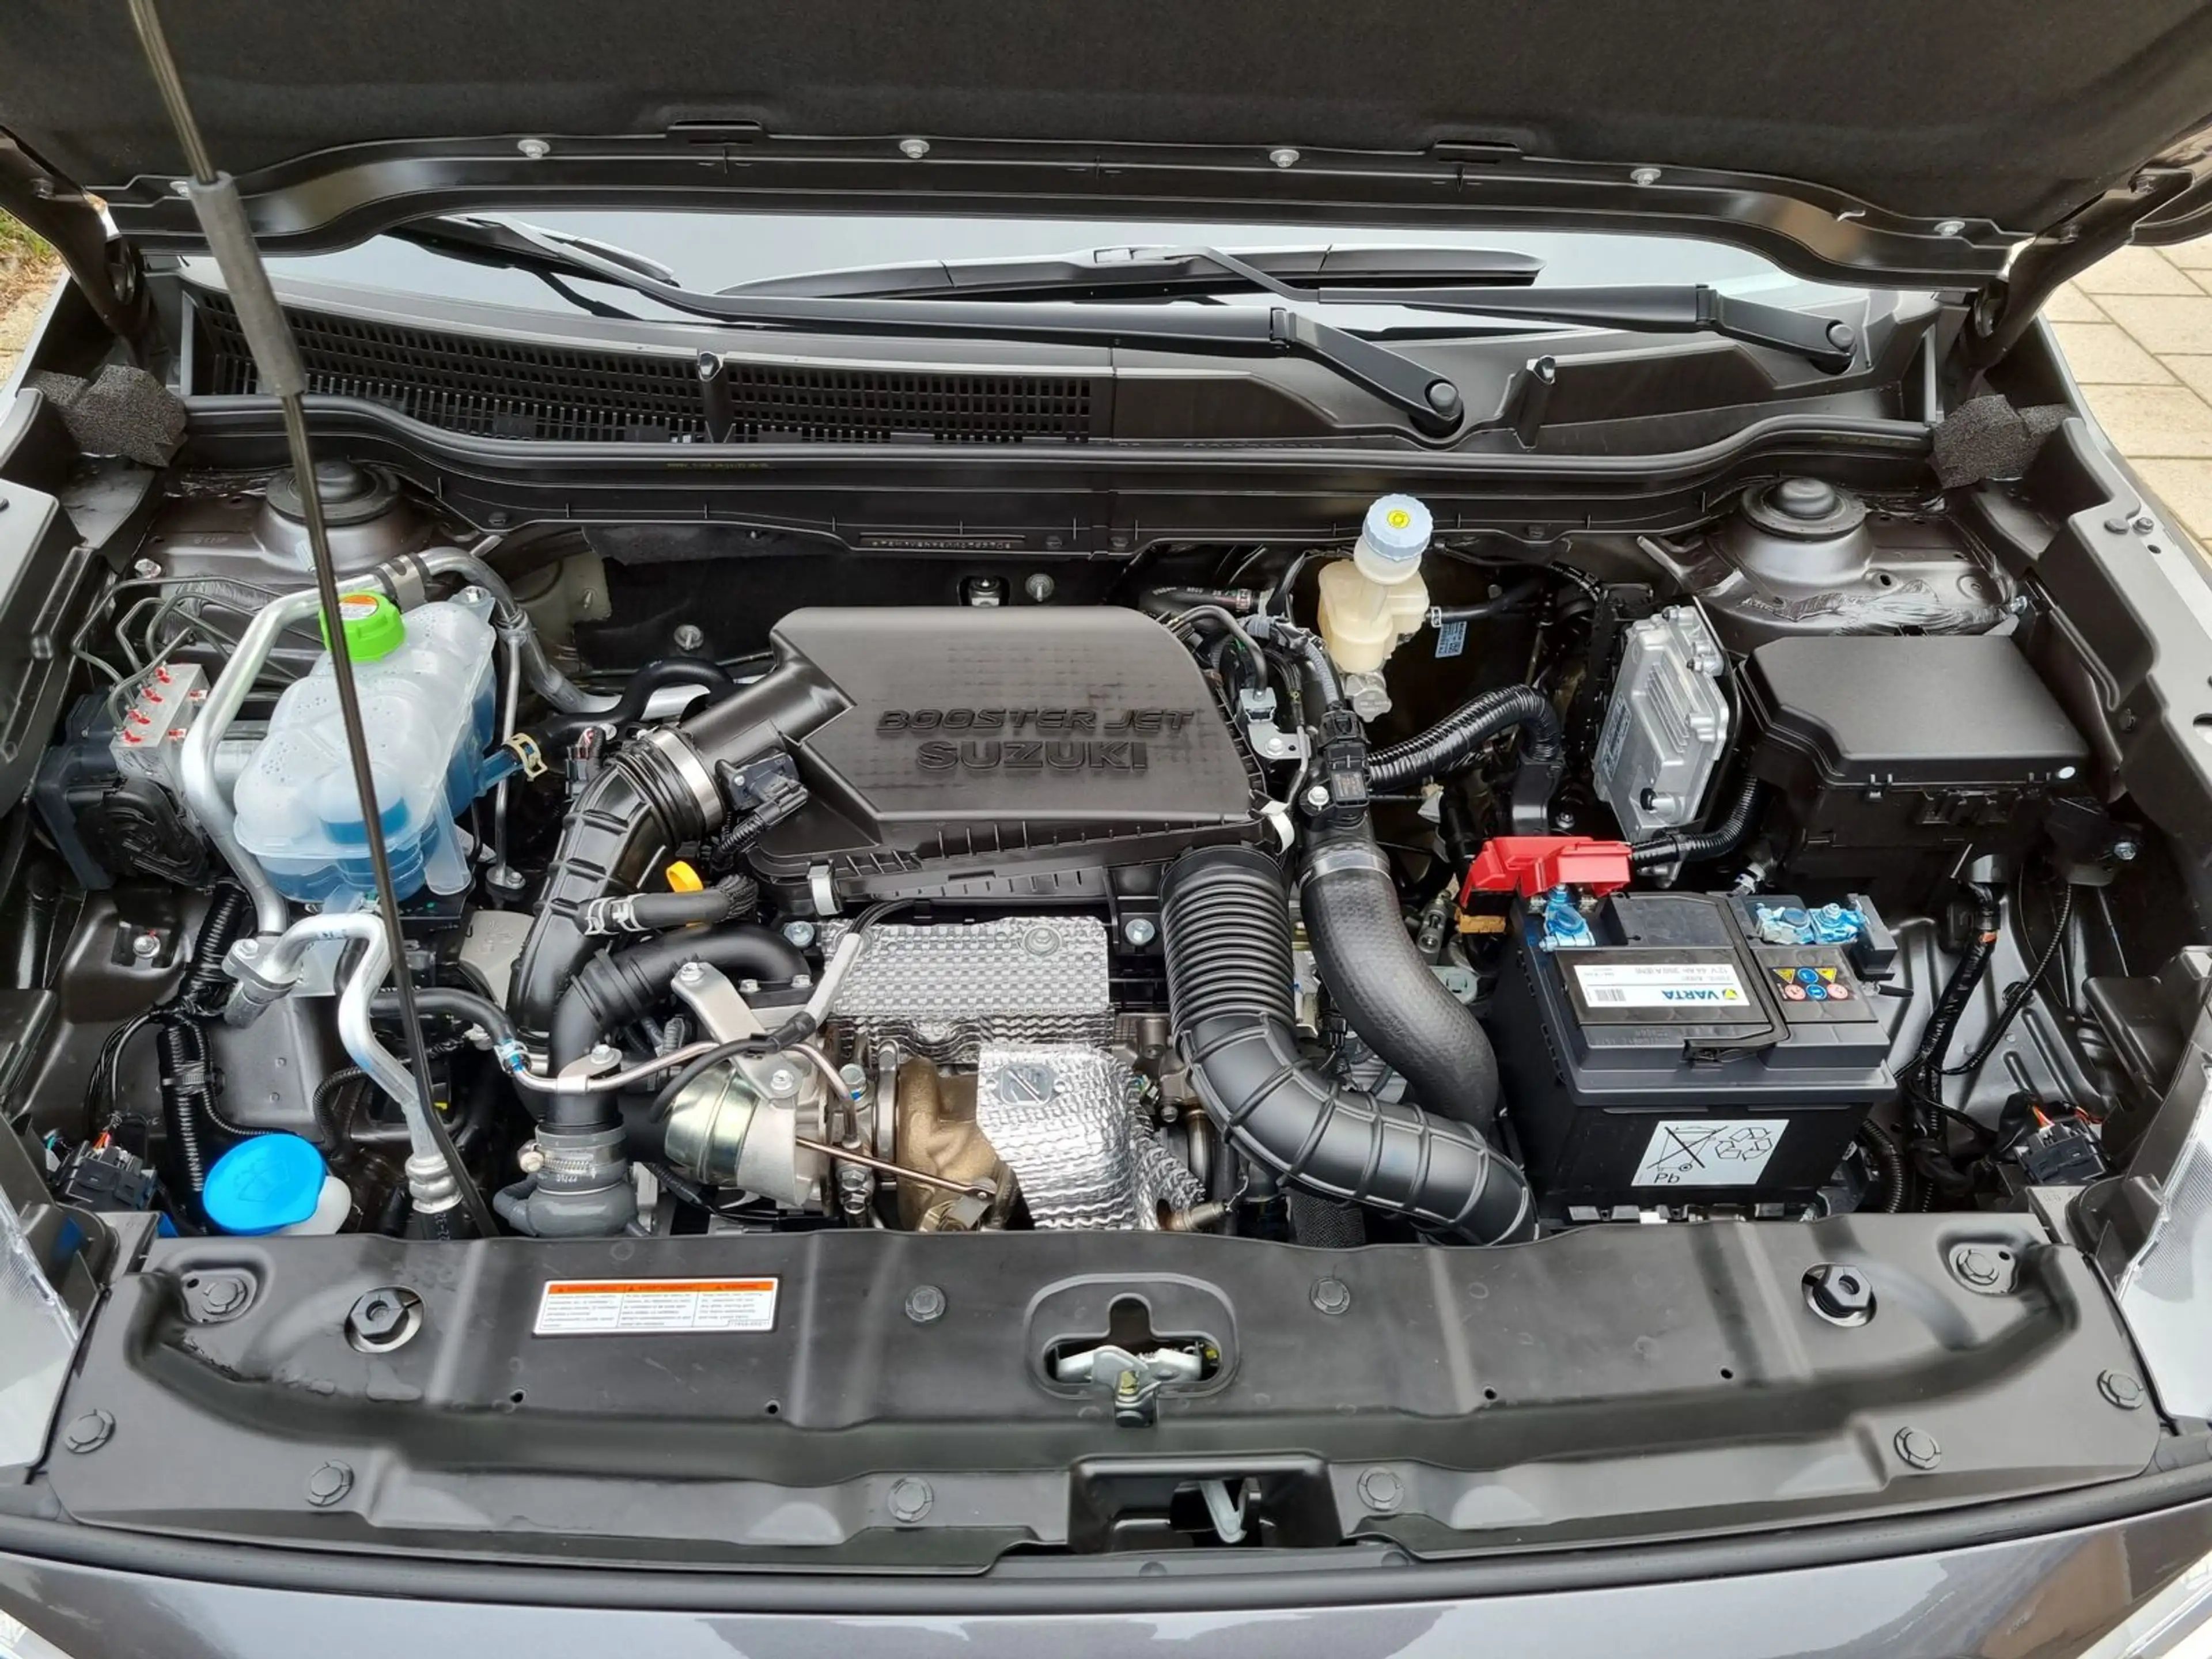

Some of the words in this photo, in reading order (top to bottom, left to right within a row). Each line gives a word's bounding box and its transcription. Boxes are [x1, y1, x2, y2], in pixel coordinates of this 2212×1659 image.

[876, 709, 1095, 730] BOOSTER
[1104, 710, 1194, 731] JET
[918, 741, 1147, 770] SUZUKI
[1661, 990, 1719, 1000] VARTA
[1653, 1173, 1680, 1184] Pb
